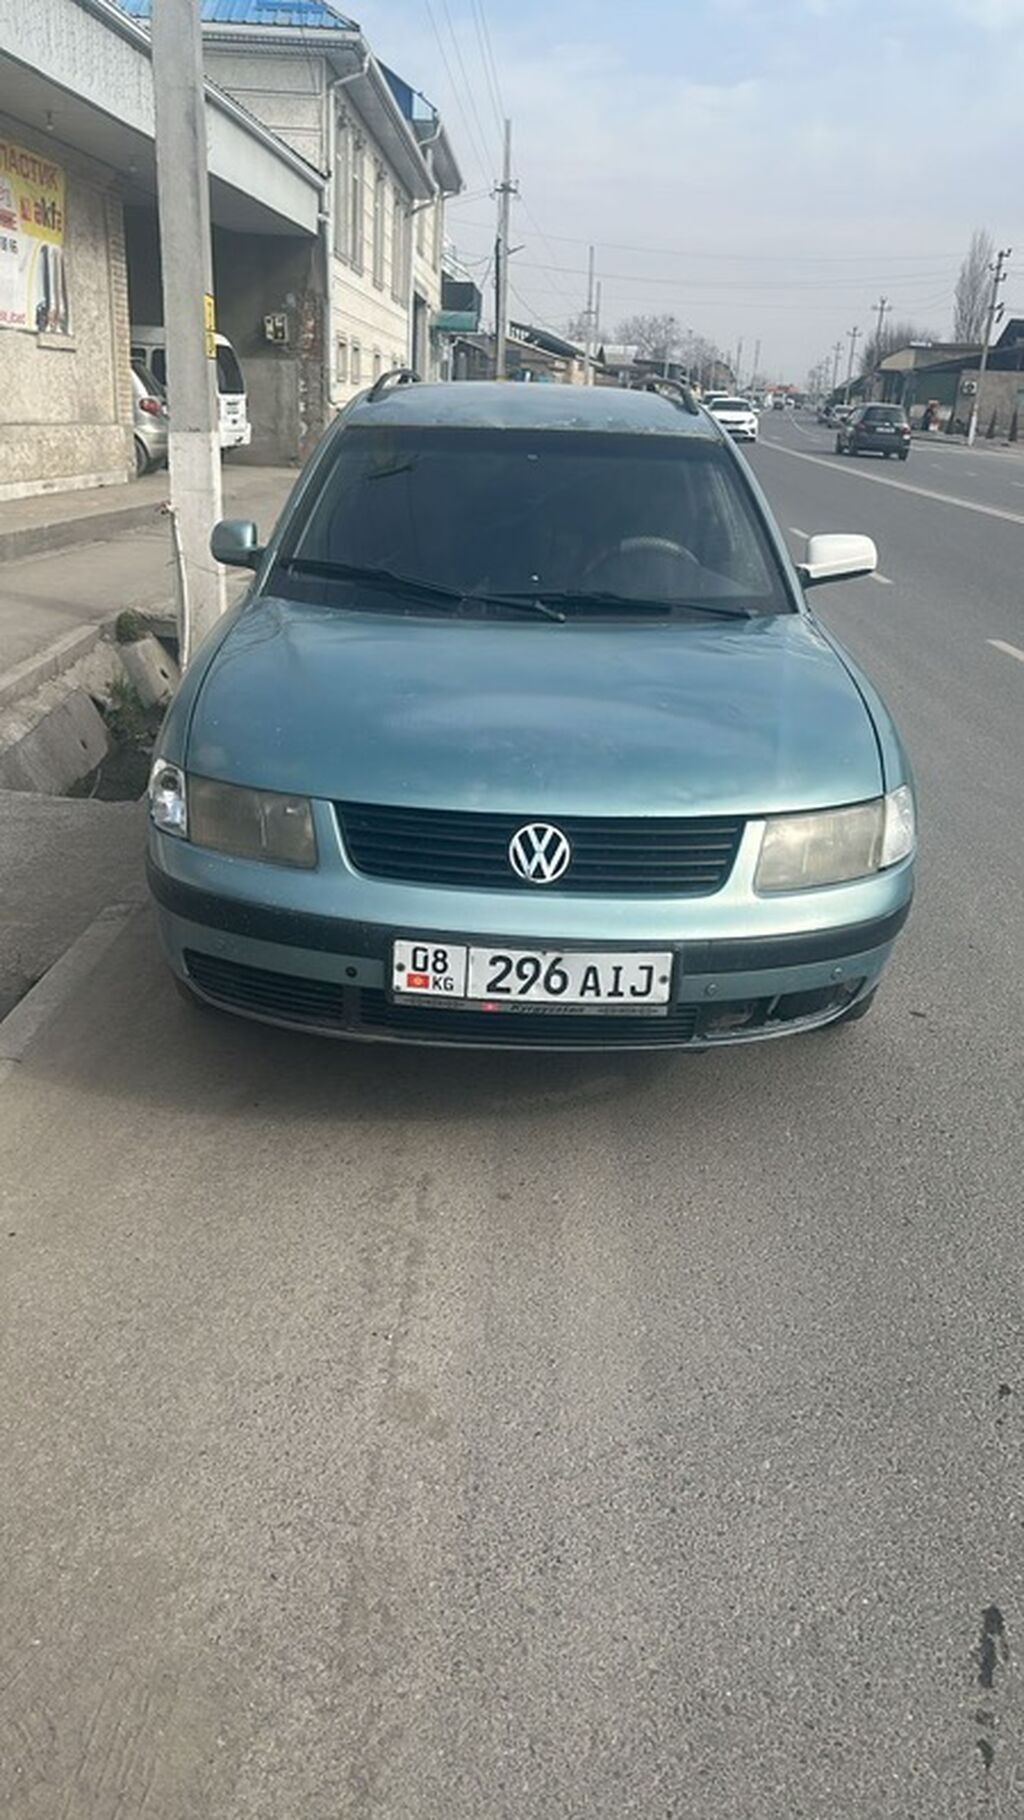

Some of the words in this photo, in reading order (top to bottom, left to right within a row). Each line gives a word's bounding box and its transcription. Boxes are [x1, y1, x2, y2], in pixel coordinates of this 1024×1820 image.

[411, 946, 449, 975] 08
[432, 975, 454, 992] KG
[486, 954, 569, 996] 296
[579, 964, 655, 998] AIJ
